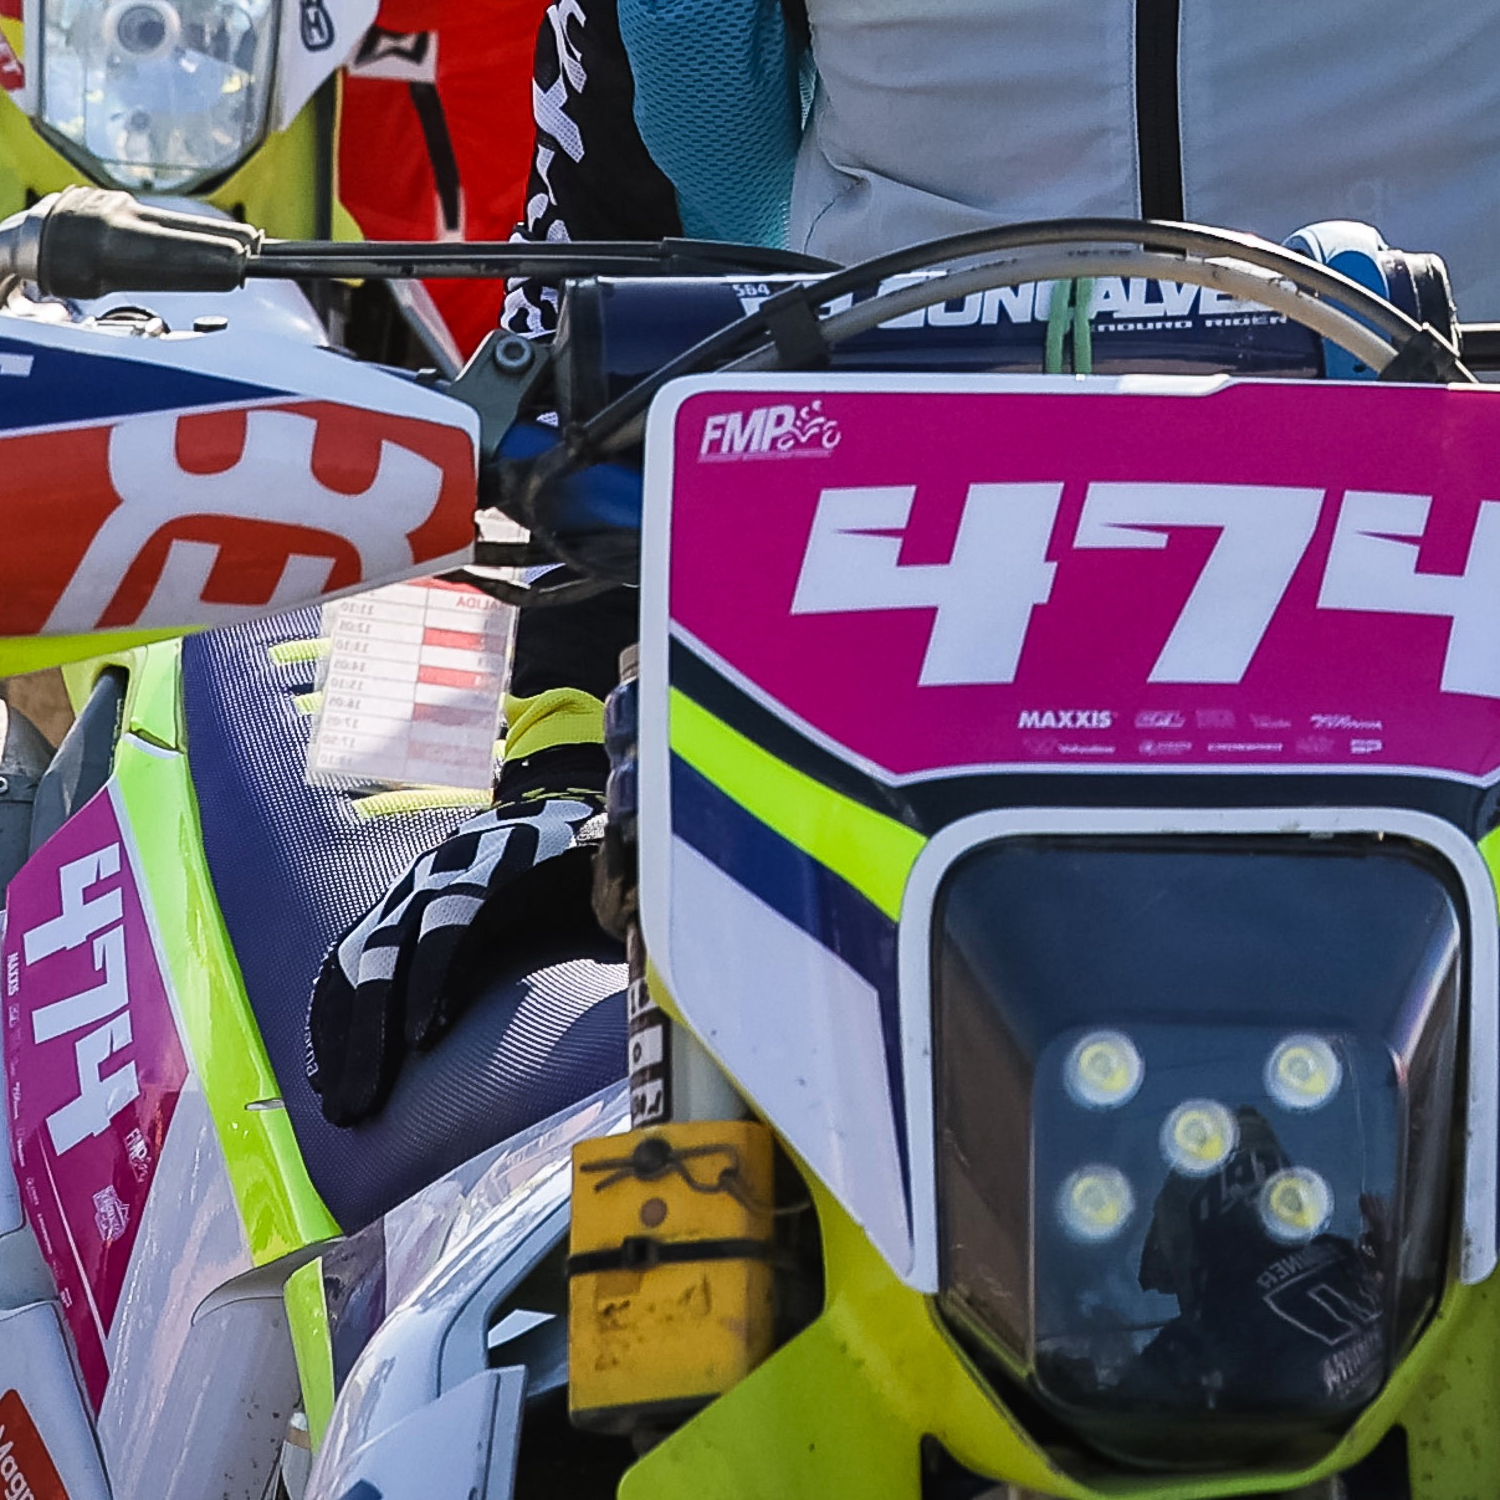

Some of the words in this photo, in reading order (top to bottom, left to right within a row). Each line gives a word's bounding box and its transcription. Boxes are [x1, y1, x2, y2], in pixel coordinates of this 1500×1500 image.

[699, 404, 797, 455] FMP
[1017, 708, 1113, 730] MAXXIS
[22, 841, 141, 1157] 474
